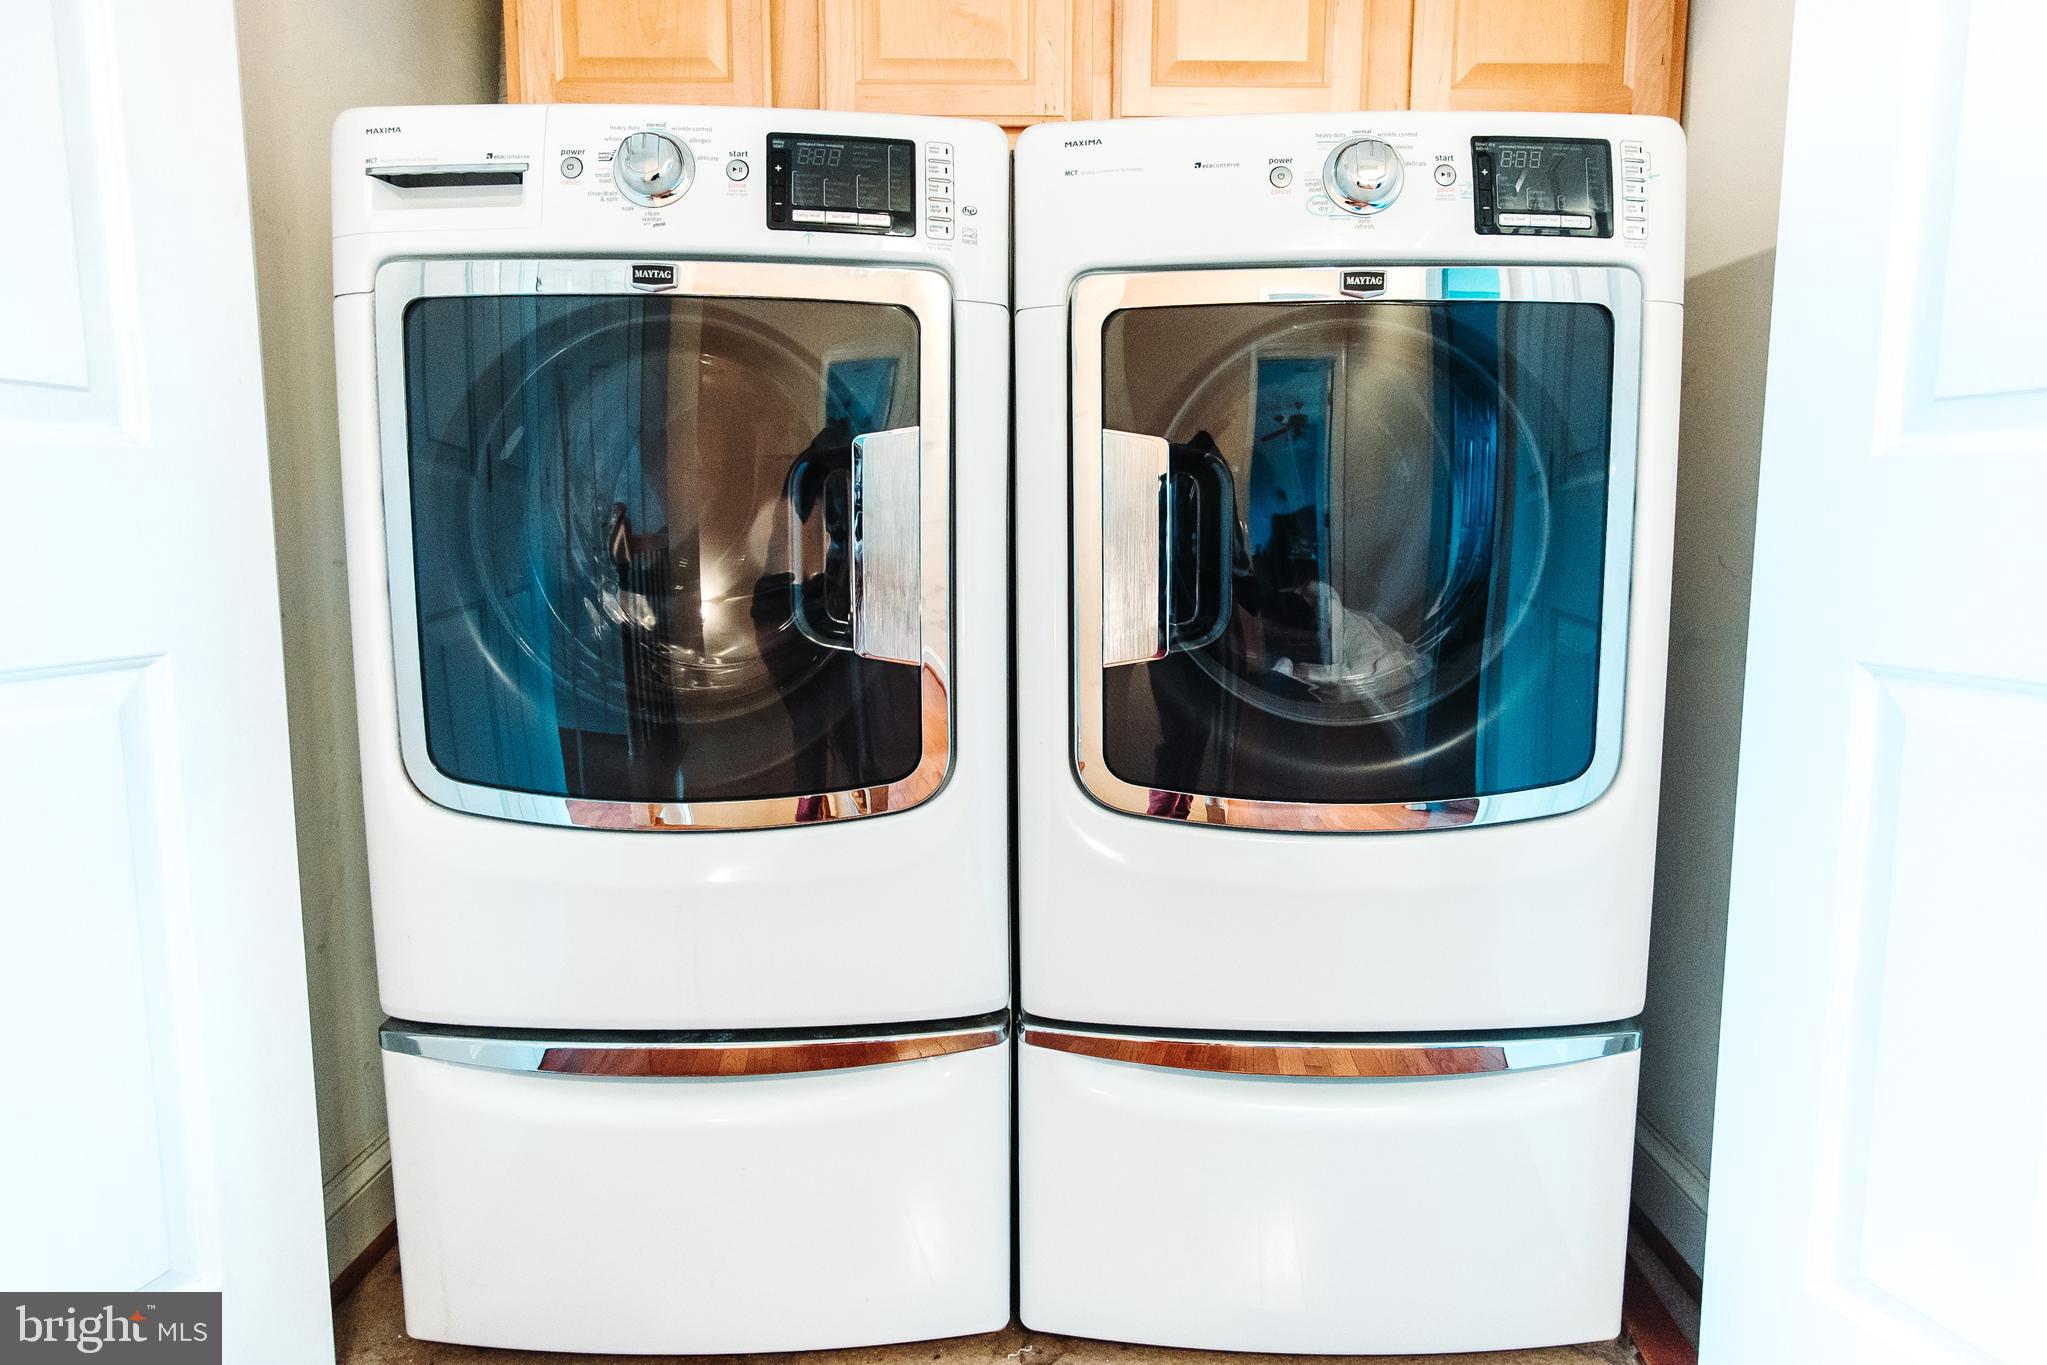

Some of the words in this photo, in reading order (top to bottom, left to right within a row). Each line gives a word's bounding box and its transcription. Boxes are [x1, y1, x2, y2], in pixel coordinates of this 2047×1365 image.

[365, 126, 402, 135] MAXIMA
[628, 124, 641, 132] duty
[1064, 138, 1103, 148] MAXIMA
[560, 149, 585, 157] power
[366, 156, 378, 164] MCT
[1268, 157, 1293, 165] power
[1434, 154, 1454, 162] start
[1064, 169, 1078, 177] MCT
[634, 269, 672, 279] MAYTAG
[1346, 276, 1383, 285] MAYTAG
